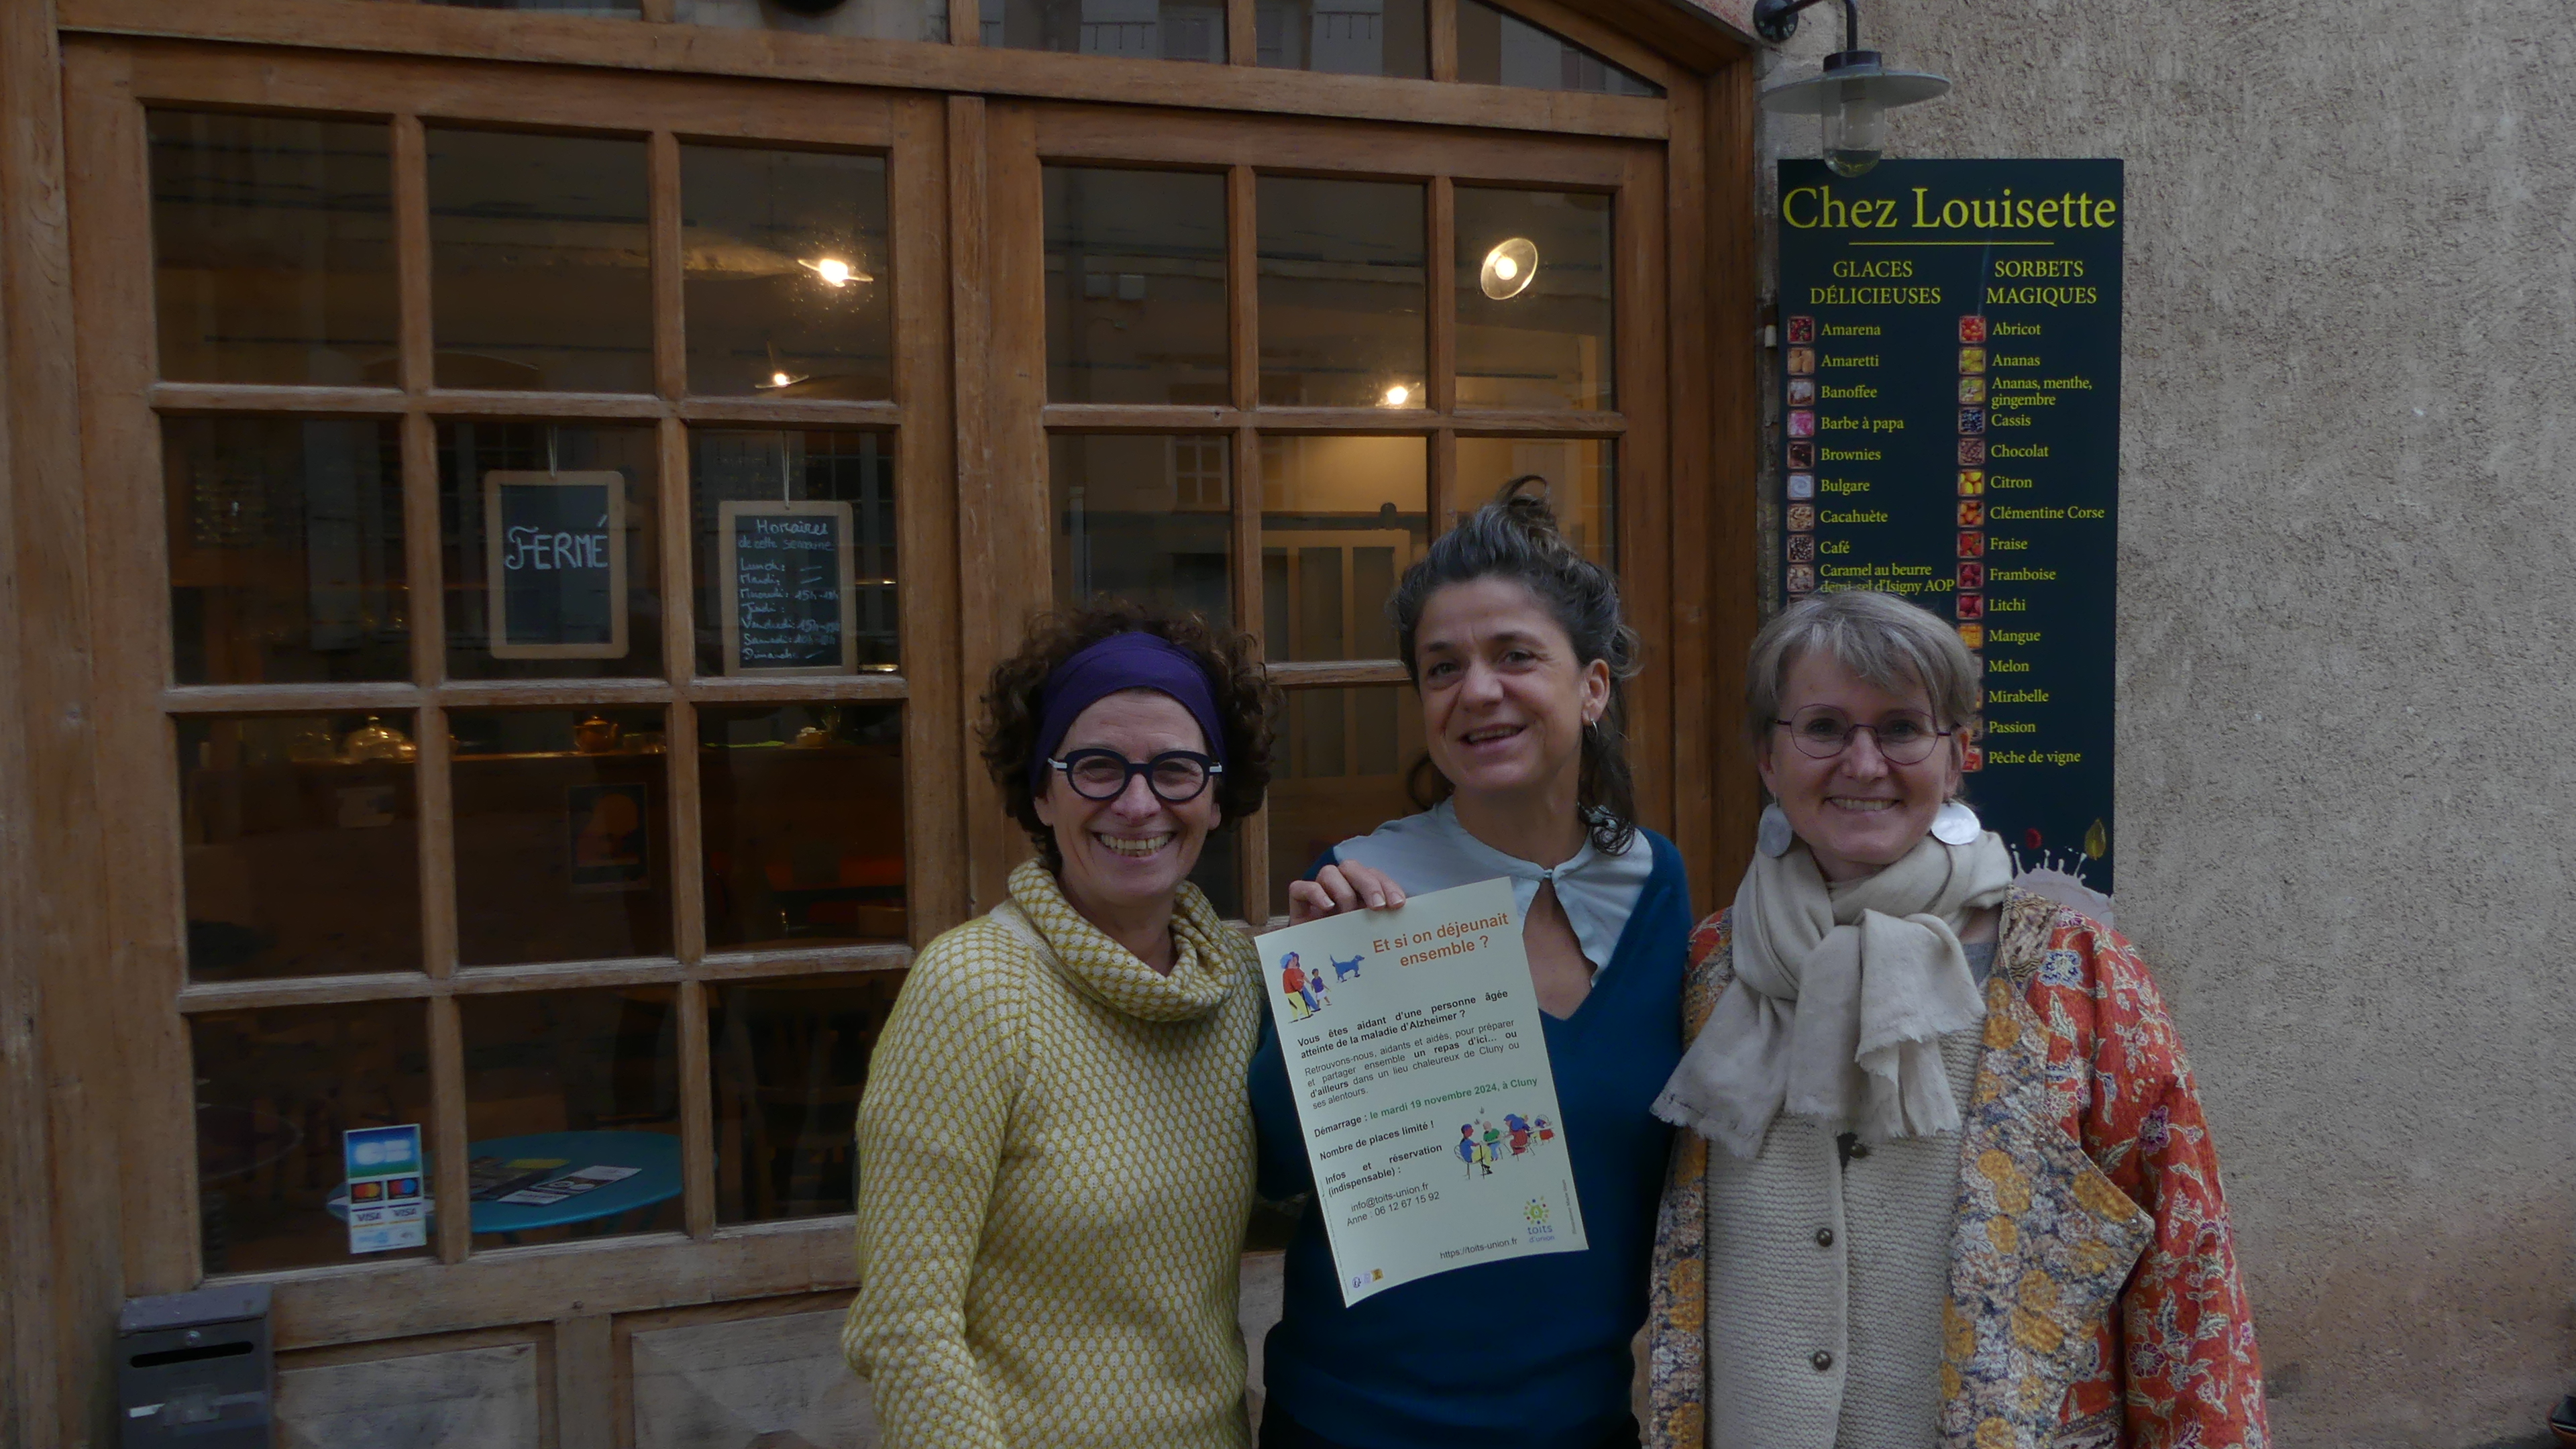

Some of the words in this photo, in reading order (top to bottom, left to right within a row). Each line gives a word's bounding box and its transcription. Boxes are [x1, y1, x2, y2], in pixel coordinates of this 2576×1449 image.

[1782, 185, 1898, 228] Chez
[1913, 189, 2116, 228] Louisette
[1833, 260, 1913, 278] GLACES
[1995, 260, 2084, 278] SORBETS
[1811, 285, 1942, 305] DÉLICIEUSES
[1986, 286, 2097, 307] MAGIQUES
[1822, 324, 1881, 335] Amarena
[1993, 323, 2041, 335] Abricot
[1821, 356, 1878, 367] Amaretti
[1993, 355, 2041, 366] Ananas
[1992, 378, 2041, 389] Ananas,
[2043, 376, 2092, 389] menthe,
[1821, 385, 1878, 398] Banoffee
[1992, 393, 2055, 410] gingembre
[1822, 417, 1859, 429] Barbe
[1862, 418, 1870, 429] à
[1873, 420, 1904, 433] papa
[1991, 414, 2031, 426] Cassis
[1821, 448, 1881, 461] Brownies
[1991, 445, 2049, 458] Chocolat
[1821, 479, 1870, 494] Bulgare
[1990, 476, 2033, 488] Citron
[1820, 510, 1888, 523] Cacahuète
[1990, 506, 2065, 519] Clémentine
[2068, 506, 2105, 519] Corse
[756, 519, 828, 535] Horaires
[504, 515, 608, 570] FERMÉ
[1820, 541, 1850, 554] Café
[1990, 537, 2028, 550] Fraise
[1820, 564, 1872, 576] Caramel
[1874, 567, 1889, 576] au
[1892, 563, 1932, 576] beurre
[1990, 568, 2056, 580] Framboise
[1875, 579, 1922, 595] d'Isigny
[1925, 579, 1955, 592] AOP
[1990, 599, 2026, 612] Litchi
[1990, 630, 2041, 645] Mangue
[1989, 660, 2029, 672] Melon
[1990, 690, 2049, 702] Mirabelle
[1990, 721, 2036, 733] Passion
[1990, 751, 2025, 764] Pêche
[2028, 751, 2043, 763] de
[2047, 751, 2081, 765] vigne
[1373, 938, 1391, 953] Et
[1394, 933, 1408, 949] si
[1412, 931, 1432, 944] on
[1436, 913, 1509, 938] déjeunait
[1400, 940, 1475, 967] ensemble
[1297, 1035, 1320, 1046] Vous
[1328, 1027, 1348, 1038] êtes
[1356, 1016, 1387, 1030] aidant
[1395, 1009, 1422, 1021] d'une
[1431, 997, 1476, 1015] personne
[1485, 990, 1508, 1002] âgée
[1301, 1043, 1334, 1059] atteinte
[1336, 1038, 1348, 1048] de
[1350, 1036, 1359, 1044] la
[1360, 1026, 1398, 1041] maladie
[1400, 1013, 1457, 1032] d'Alzheimer
[1304, 1051, 1377, 1077] Retrouvons-nous,
[1380, 1042, 1411, 1055] aidants
[1414, 1038, 1423, 1046] et
[1426, 1032, 1452, 1044] aidés,
[1455, 1027, 1474, 1039] pour
[1478, 1020, 1514, 1034] préparer
[1307, 1078, 1316, 1087] et
[1322, 1067, 1356, 1085] partager
[1364, 1054, 1405, 1071] ensemble
[1413, 1050, 1426, 1058] un
[1434, 1042, 1460, 1054] repas
[1468, 1034, 1497, 1046] d'ici...
[1310, 1081, 1349, 1098] d'ailleurs
[1352, 1074, 1374, 1085] dans
[1377, 1070, 1389, 1079] un
[1393, 1065, 1409, 1075] lieu
[1412, 1053, 1460, 1070] chaleureux
[1464, 1050, 1475, 1059] de
[1479, 1044, 1504, 1055] Cluny
[1508, 1042, 1519, 1050] ou
[1312, 1099, 1327, 1110] ses
[1328, 1087, 1368, 1104] alentours.
[1314, 1117, 1362, 1138] Démarrage
[1369, 1112, 1379, 1120] le
[1381, 1102, 1408, 1116] mardi
[1410, 1099, 1422, 1109] 19
[1424, 1089, 1472, 1106] novembre
[1474, 1083, 1500, 1095] 2024,
[1502, 1081, 1509, 1089] à
[1510, 1078, 1538, 1088] Cluny
[1320, 1144, 1353, 1161] Nombre
[1355, 1138, 1367, 1148] de
[1369, 1130, 1400, 1146] places
[1401, 1122, 1428, 1135] limité
[1325, 1171, 1346, 1185] Infos
[1362, 1162, 1372, 1171] et
[1389, 1145, 1442, 1164] réservation
[1328, 1167, 1395, 1198] (indispensable)
[1351, 1182, 1429, 1212] info@toits-union.fr
[356, 1212, 381, 1221] VISA
[393, 1208, 417, 1216] VISA
[1347, 1213, 1368, 1227] Anne
[1374, 1205, 1386, 1216] 06
[1388, 1201, 1399, 1212] 12
[1401, 1197, 1411, 1208] 67
[1415, 1194, 1426, 1204] 15
[1428, 1191, 1440, 1201] 92
[1527, 1225, 1553, 1235] toits
[1440, 1237, 1517, 1259] https://toits-union.fr
